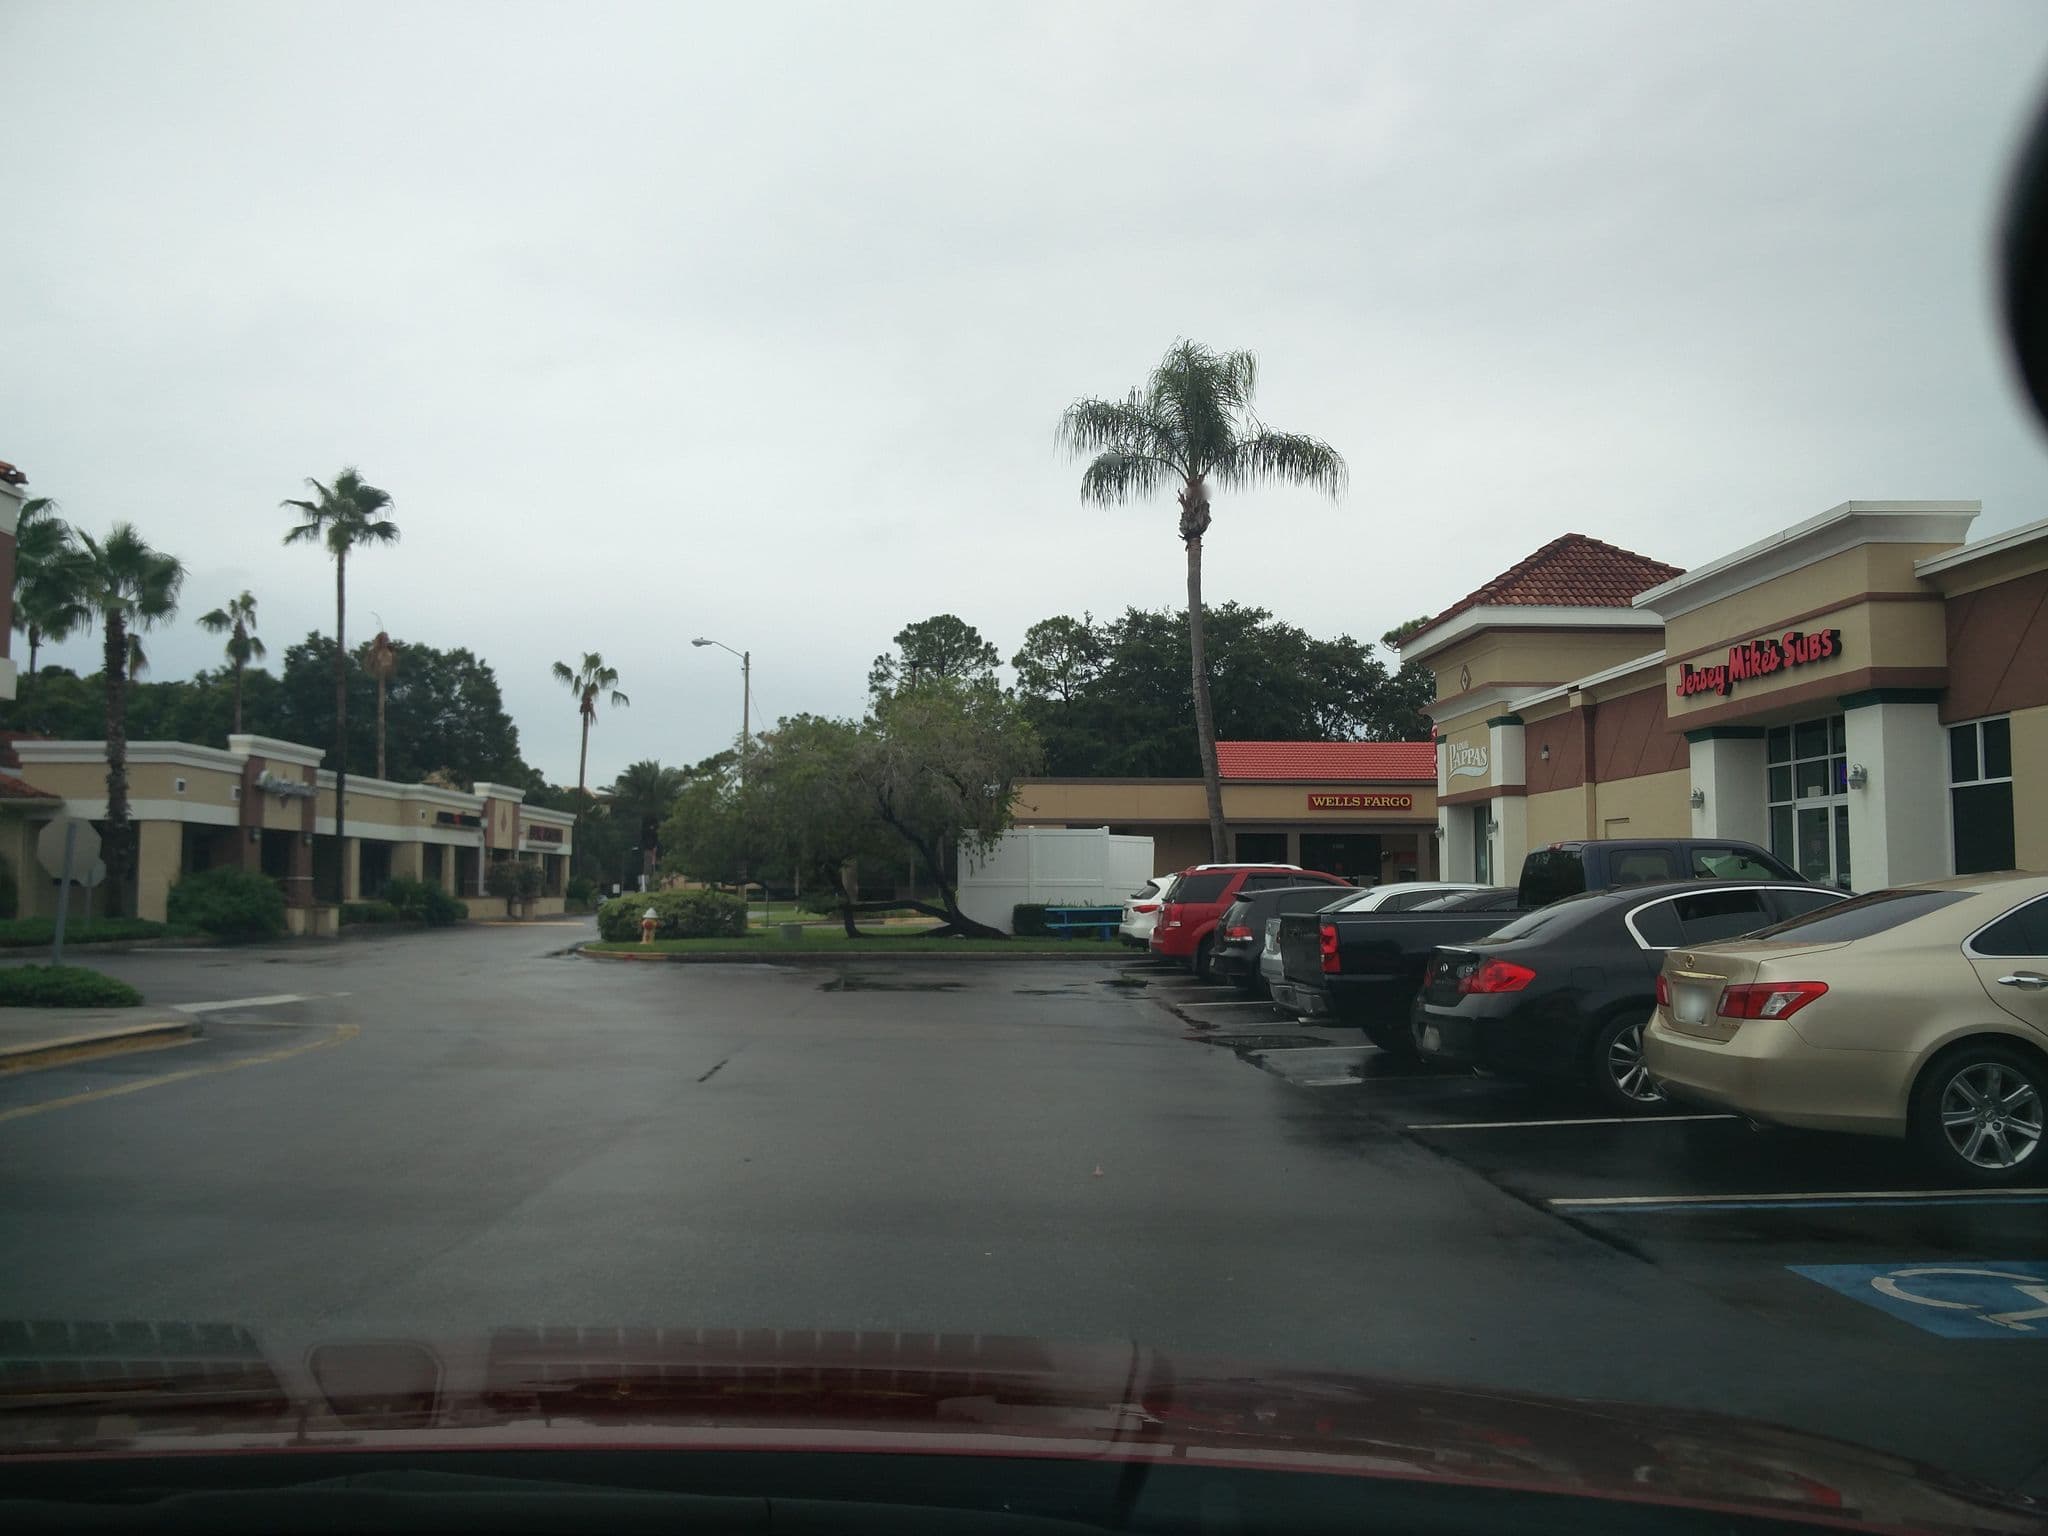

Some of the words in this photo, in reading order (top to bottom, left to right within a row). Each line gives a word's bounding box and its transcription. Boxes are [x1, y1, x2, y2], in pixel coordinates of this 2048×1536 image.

[1676, 663, 1725, 697] Jersey
[1728, 640, 1780, 683] Mike's
[1450, 744, 1488, 770] PAPPAS
[1311, 796, 1360, 807] WELLS
[1363, 796, 1411, 807] FARGO
